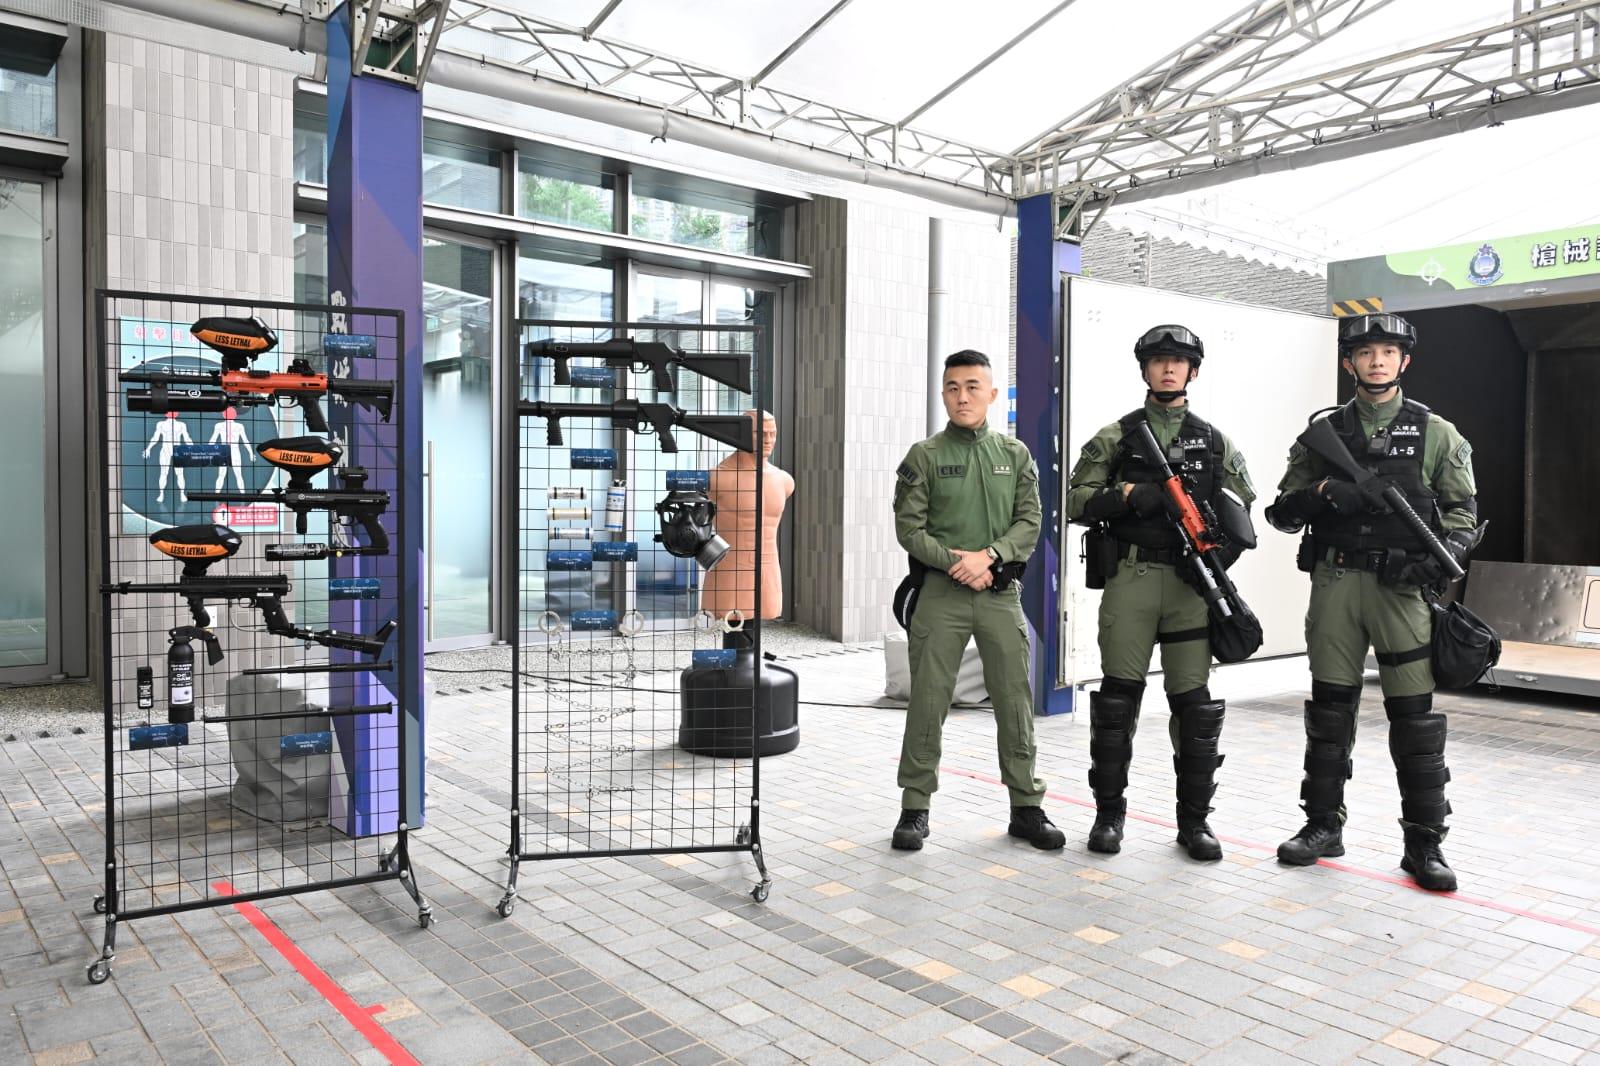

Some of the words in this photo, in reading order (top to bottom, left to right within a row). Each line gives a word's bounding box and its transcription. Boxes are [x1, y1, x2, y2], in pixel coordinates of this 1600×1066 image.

[1532, 235, 1600, 268] 槍械
[215, 334, 230, 345] LESS
[230, 336, 251, 348] LETHAL
[280, 451, 293, 462] LESS
[293, 453, 313, 463] LETHAL
[171, 545, 185, 555] LESS
[186, 546, 207, 556] LETHAL
